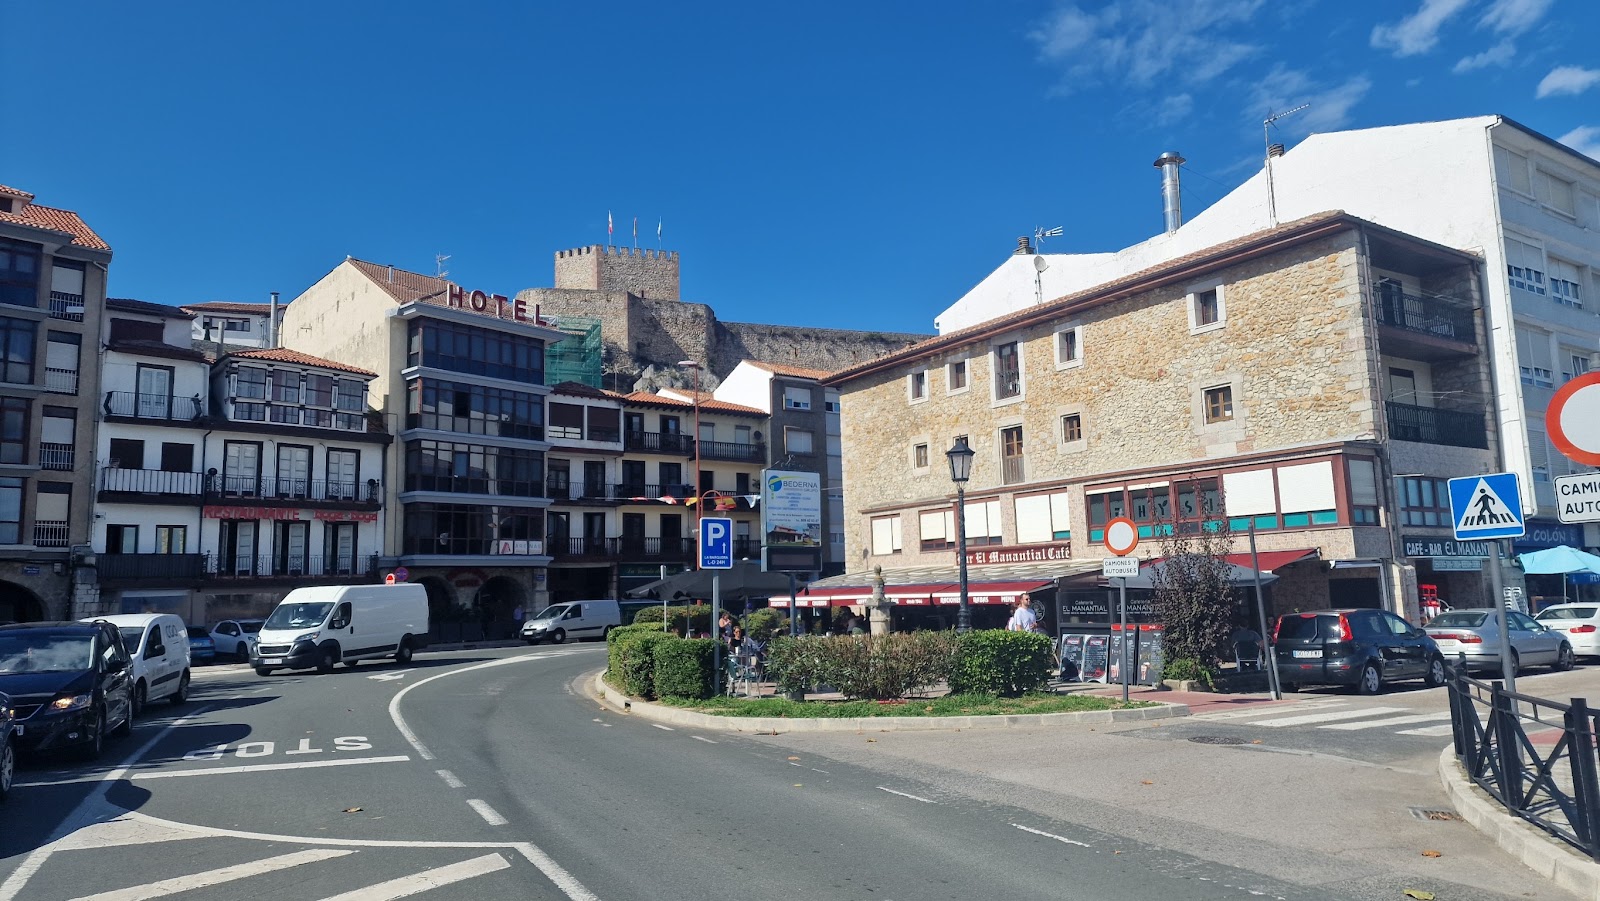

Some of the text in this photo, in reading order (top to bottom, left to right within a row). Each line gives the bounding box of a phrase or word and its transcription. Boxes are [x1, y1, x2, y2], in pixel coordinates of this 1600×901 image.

[446, 283, 547, 327] HOTEL
[783, 480, 818, 488] BEDERNA
[202, 505, 300, 521] RESTAURANTE
[707, 522, 725, 547] P
[1533, 527, 1566, 543] COLÓN
[975, 552, 986, 563] El
[989, 548, 1046, 563] Manantial
[1047, 546, 1070, 560] Café
[1406, 540, 1424, 555] CAFÉ
[1429, 543, 1442, 555] BAR
[1445, 541, 1456, 555] EL
[183, 736, 372, 761] STOP
